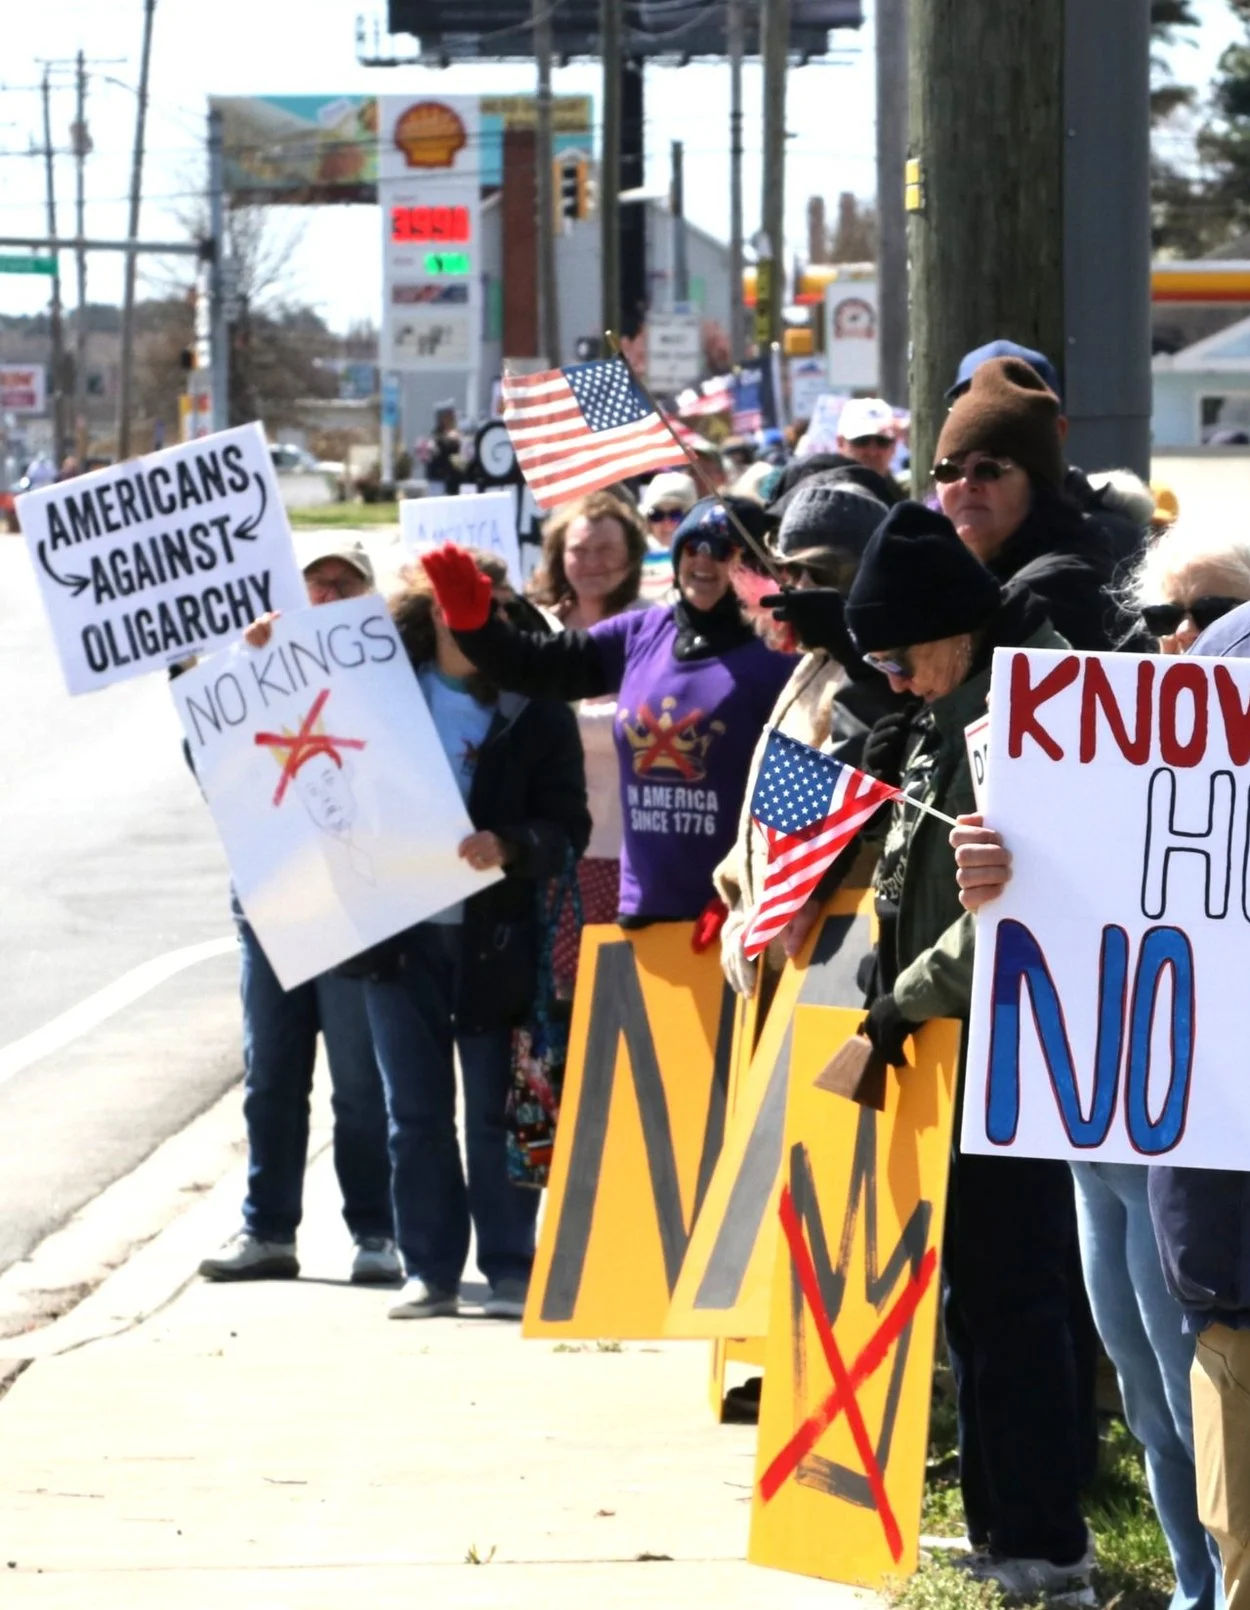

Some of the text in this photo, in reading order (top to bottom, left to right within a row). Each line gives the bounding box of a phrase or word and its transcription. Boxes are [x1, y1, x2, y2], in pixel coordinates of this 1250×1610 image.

[46, 444, 249, 550] AMERICANS
[90, 515, 235, 604] AGAINST
[81, 569, 273, 673] OLIGARCHY
[184, 616, 397, 746] NO KINGS
[627, 785, 719, 812] IN AMERICA
[631, 808, 716, 835] SINCE 1776
[985, 918, 1197, 1157] NO
